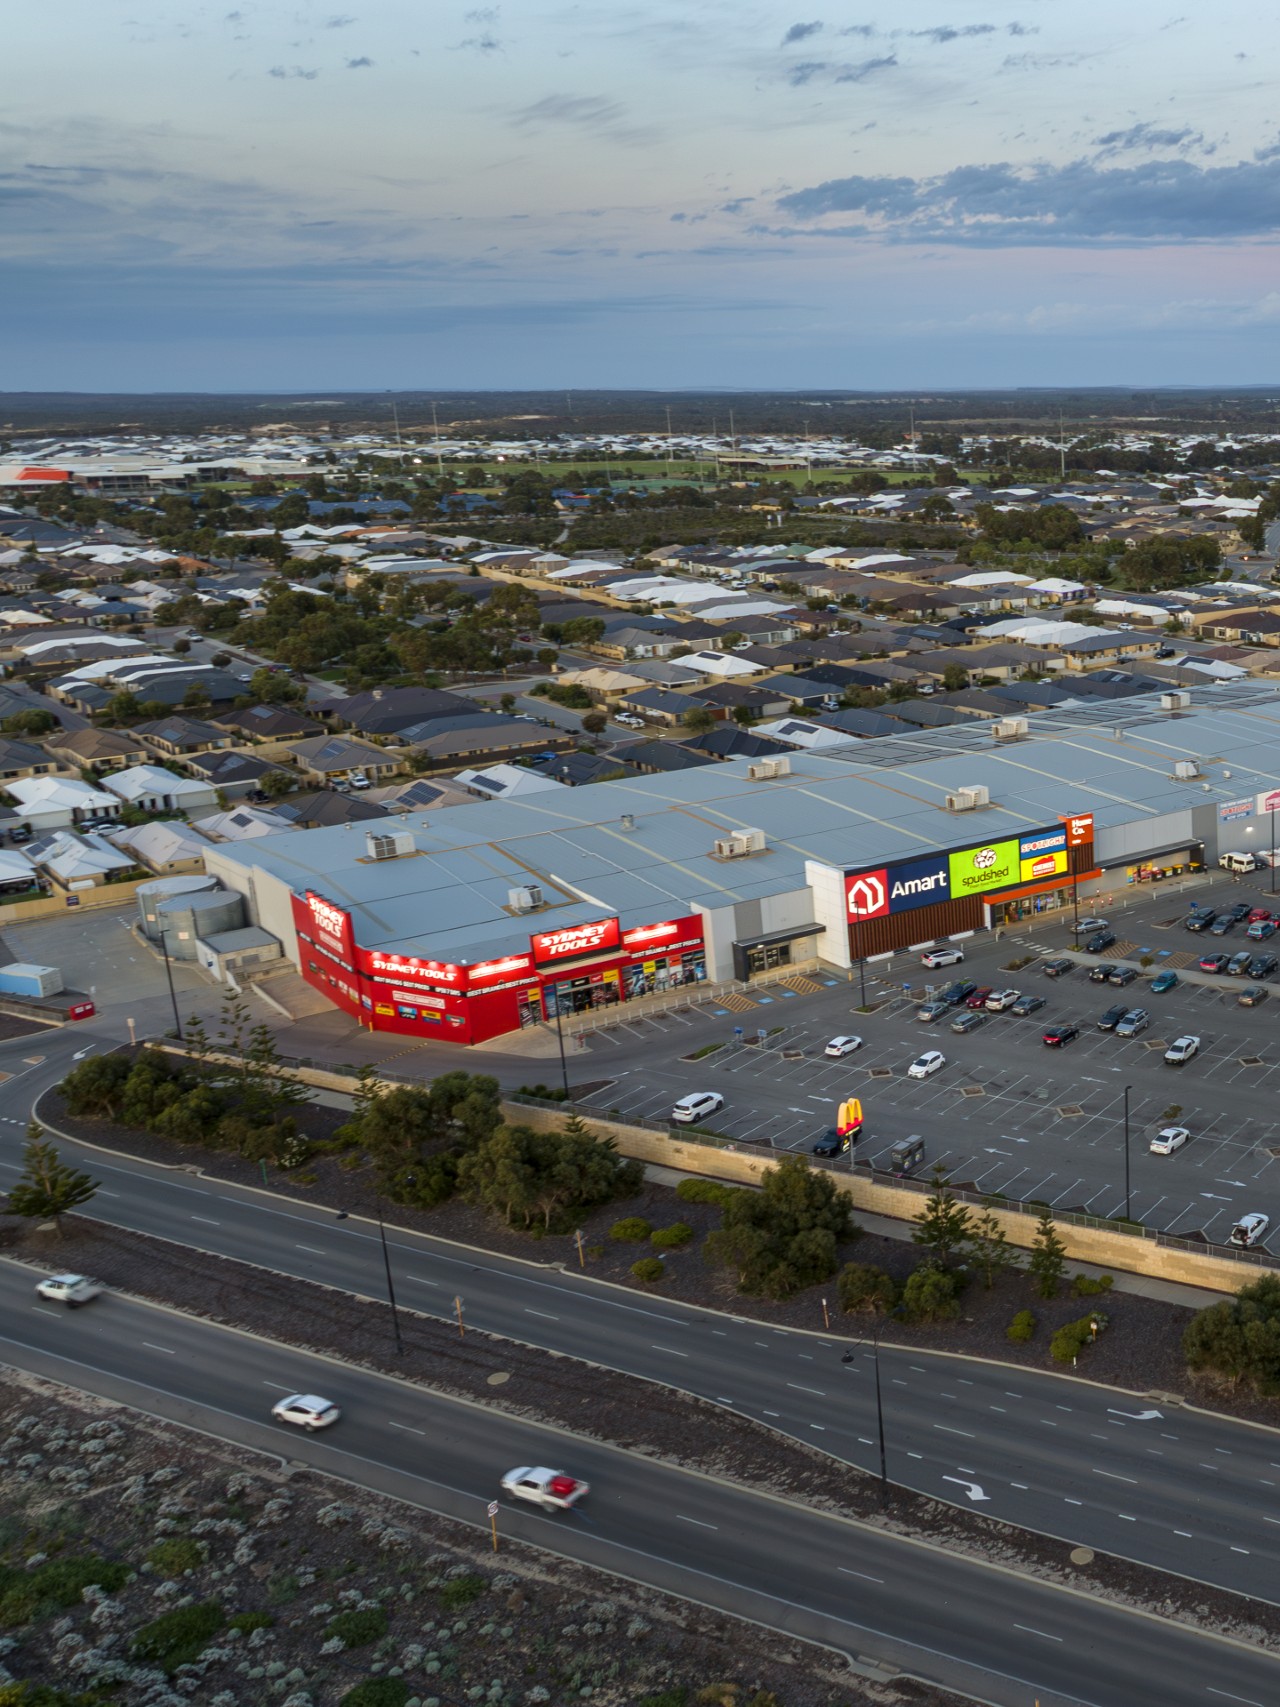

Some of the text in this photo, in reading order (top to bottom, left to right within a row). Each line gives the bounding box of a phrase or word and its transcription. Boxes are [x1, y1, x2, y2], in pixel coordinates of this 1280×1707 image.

[1021, 835, 1065, 853] SPOTLIGHT
[891, 871, 947, 898] Amart
[962, 866, 1008, 887] spudshed
[309, 898, 344, 926] SYDNEY
[314, 912, 342, 938] TOOLS
[540, 924, 608, 947] SYDNEY
[549, 934, 604, 954] TOOLS
[373, 960, 419, 974] SYDNEY
[419, 968, 457, 981] TOOLS
